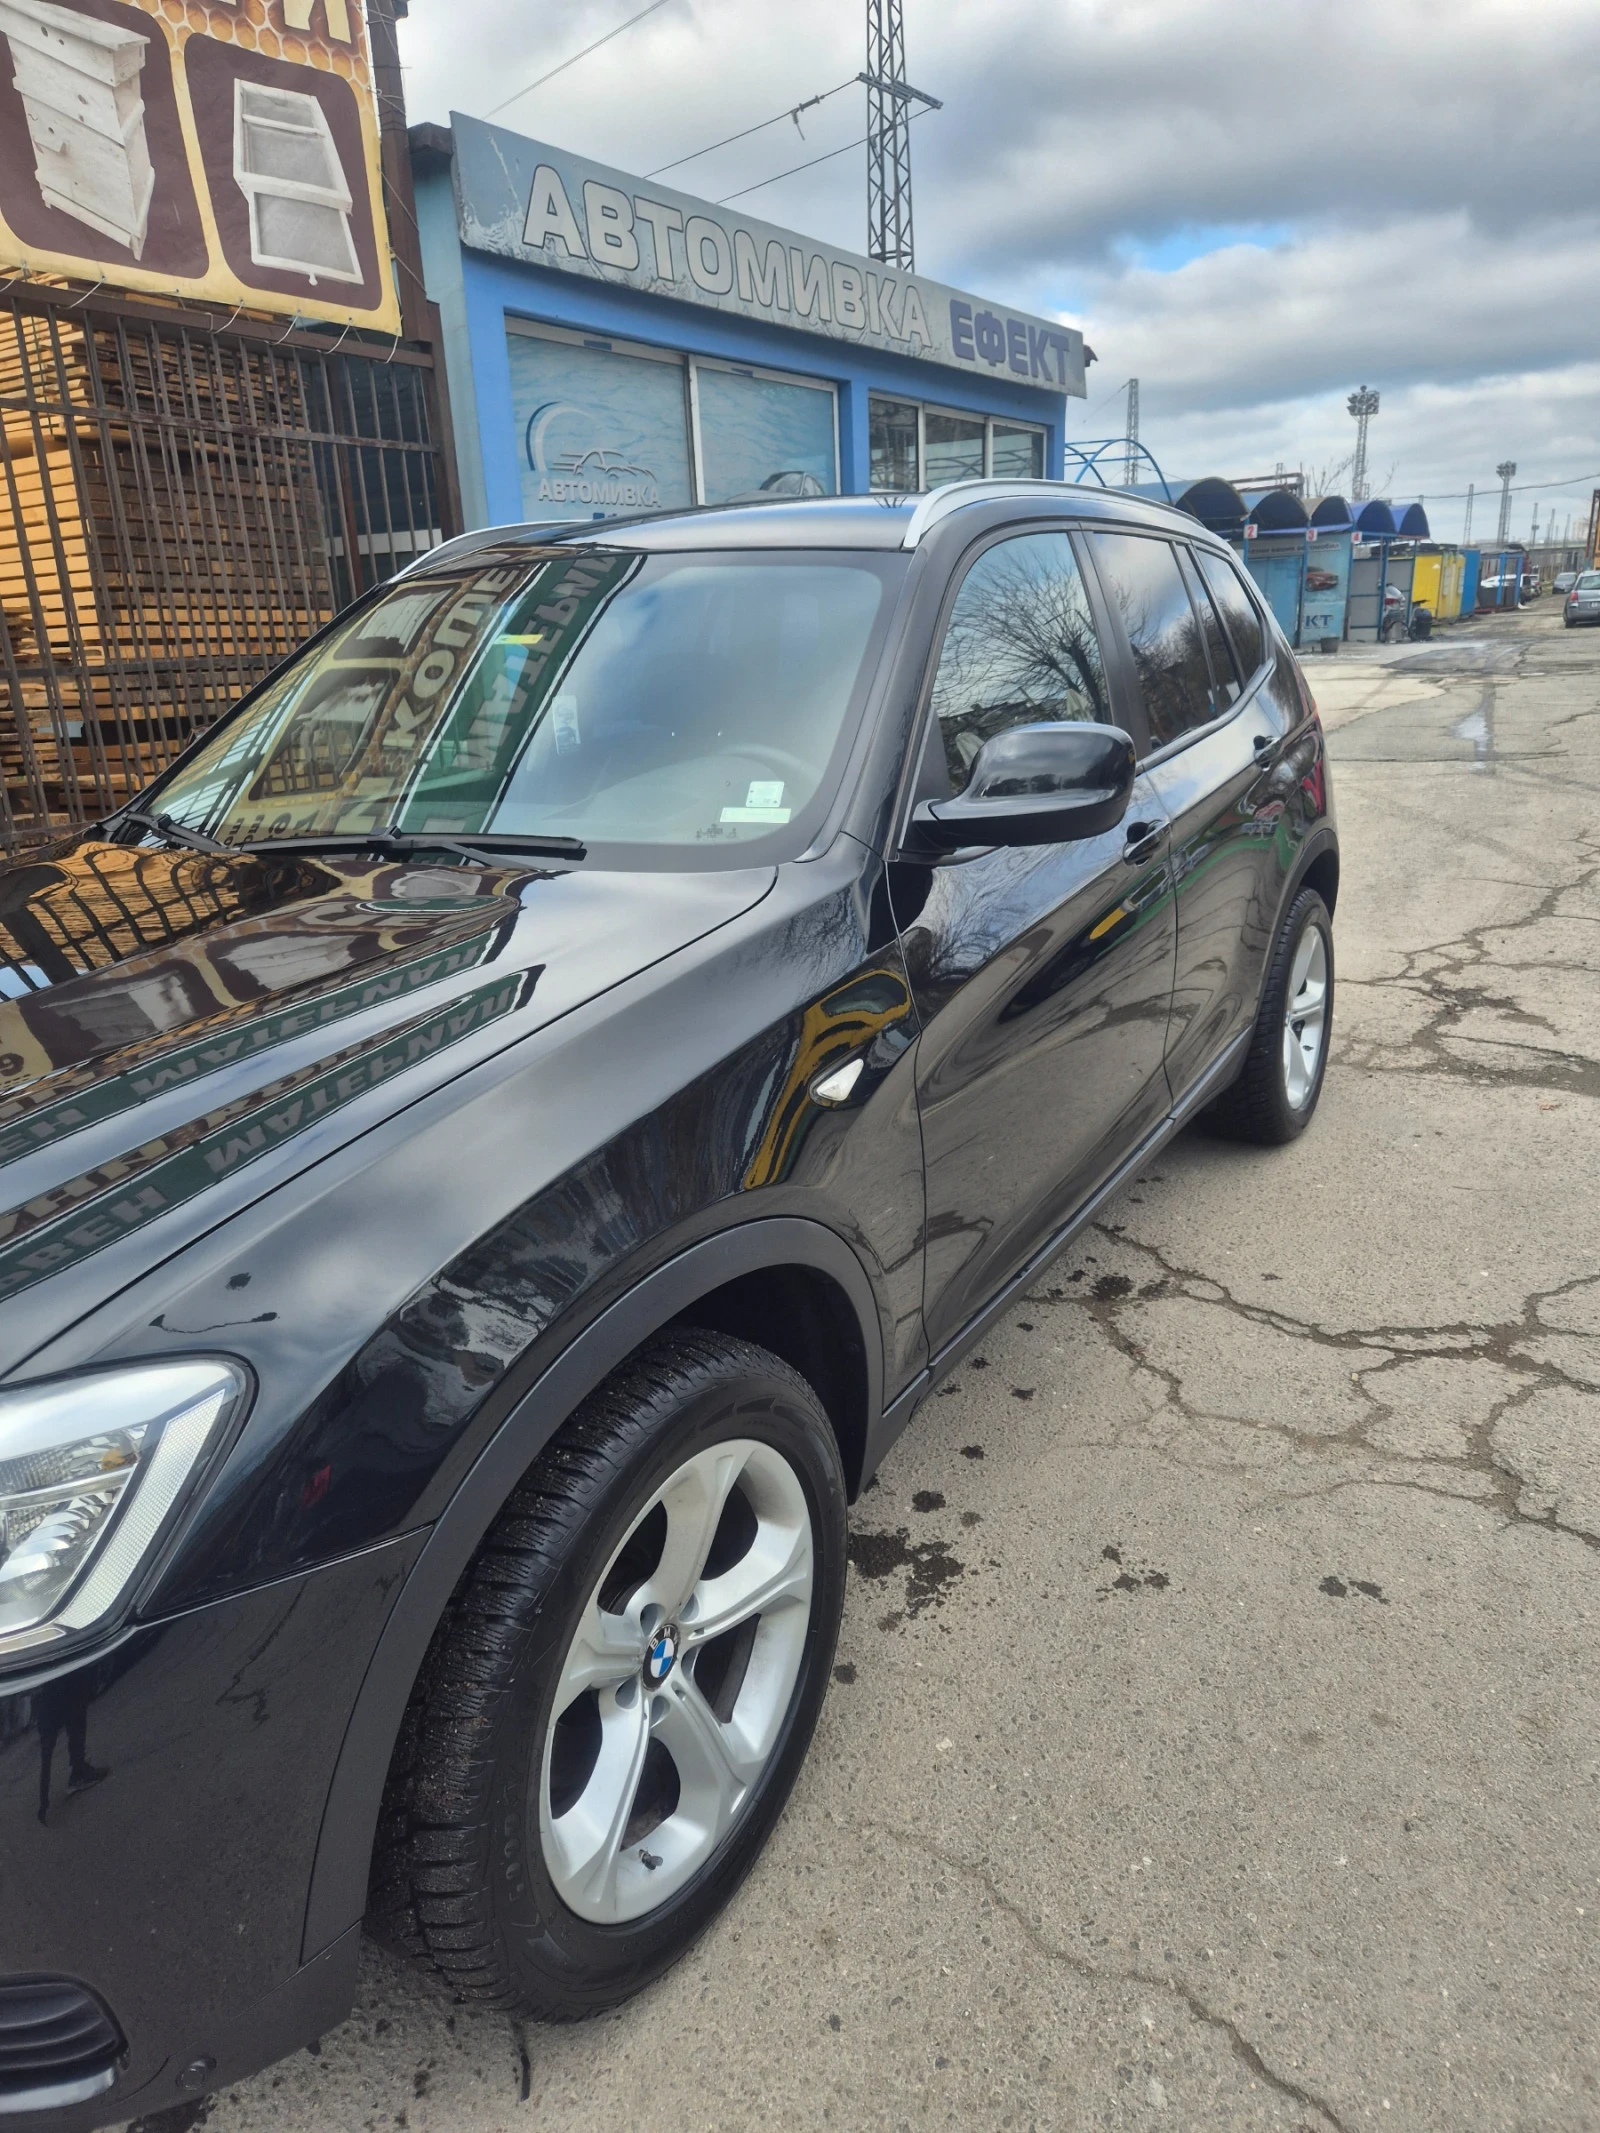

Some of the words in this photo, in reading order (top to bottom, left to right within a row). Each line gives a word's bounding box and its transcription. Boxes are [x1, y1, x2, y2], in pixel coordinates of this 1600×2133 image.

[522, 164, 931, 348] АВТОМИВКА
[949, 299, 1070, 385] ЕФЕКТ
[538, 478, 661, 508] АВТОМИВКА
[1247, 525, 1254, 538] 2
[1308, 529, 1315, 539] 3
